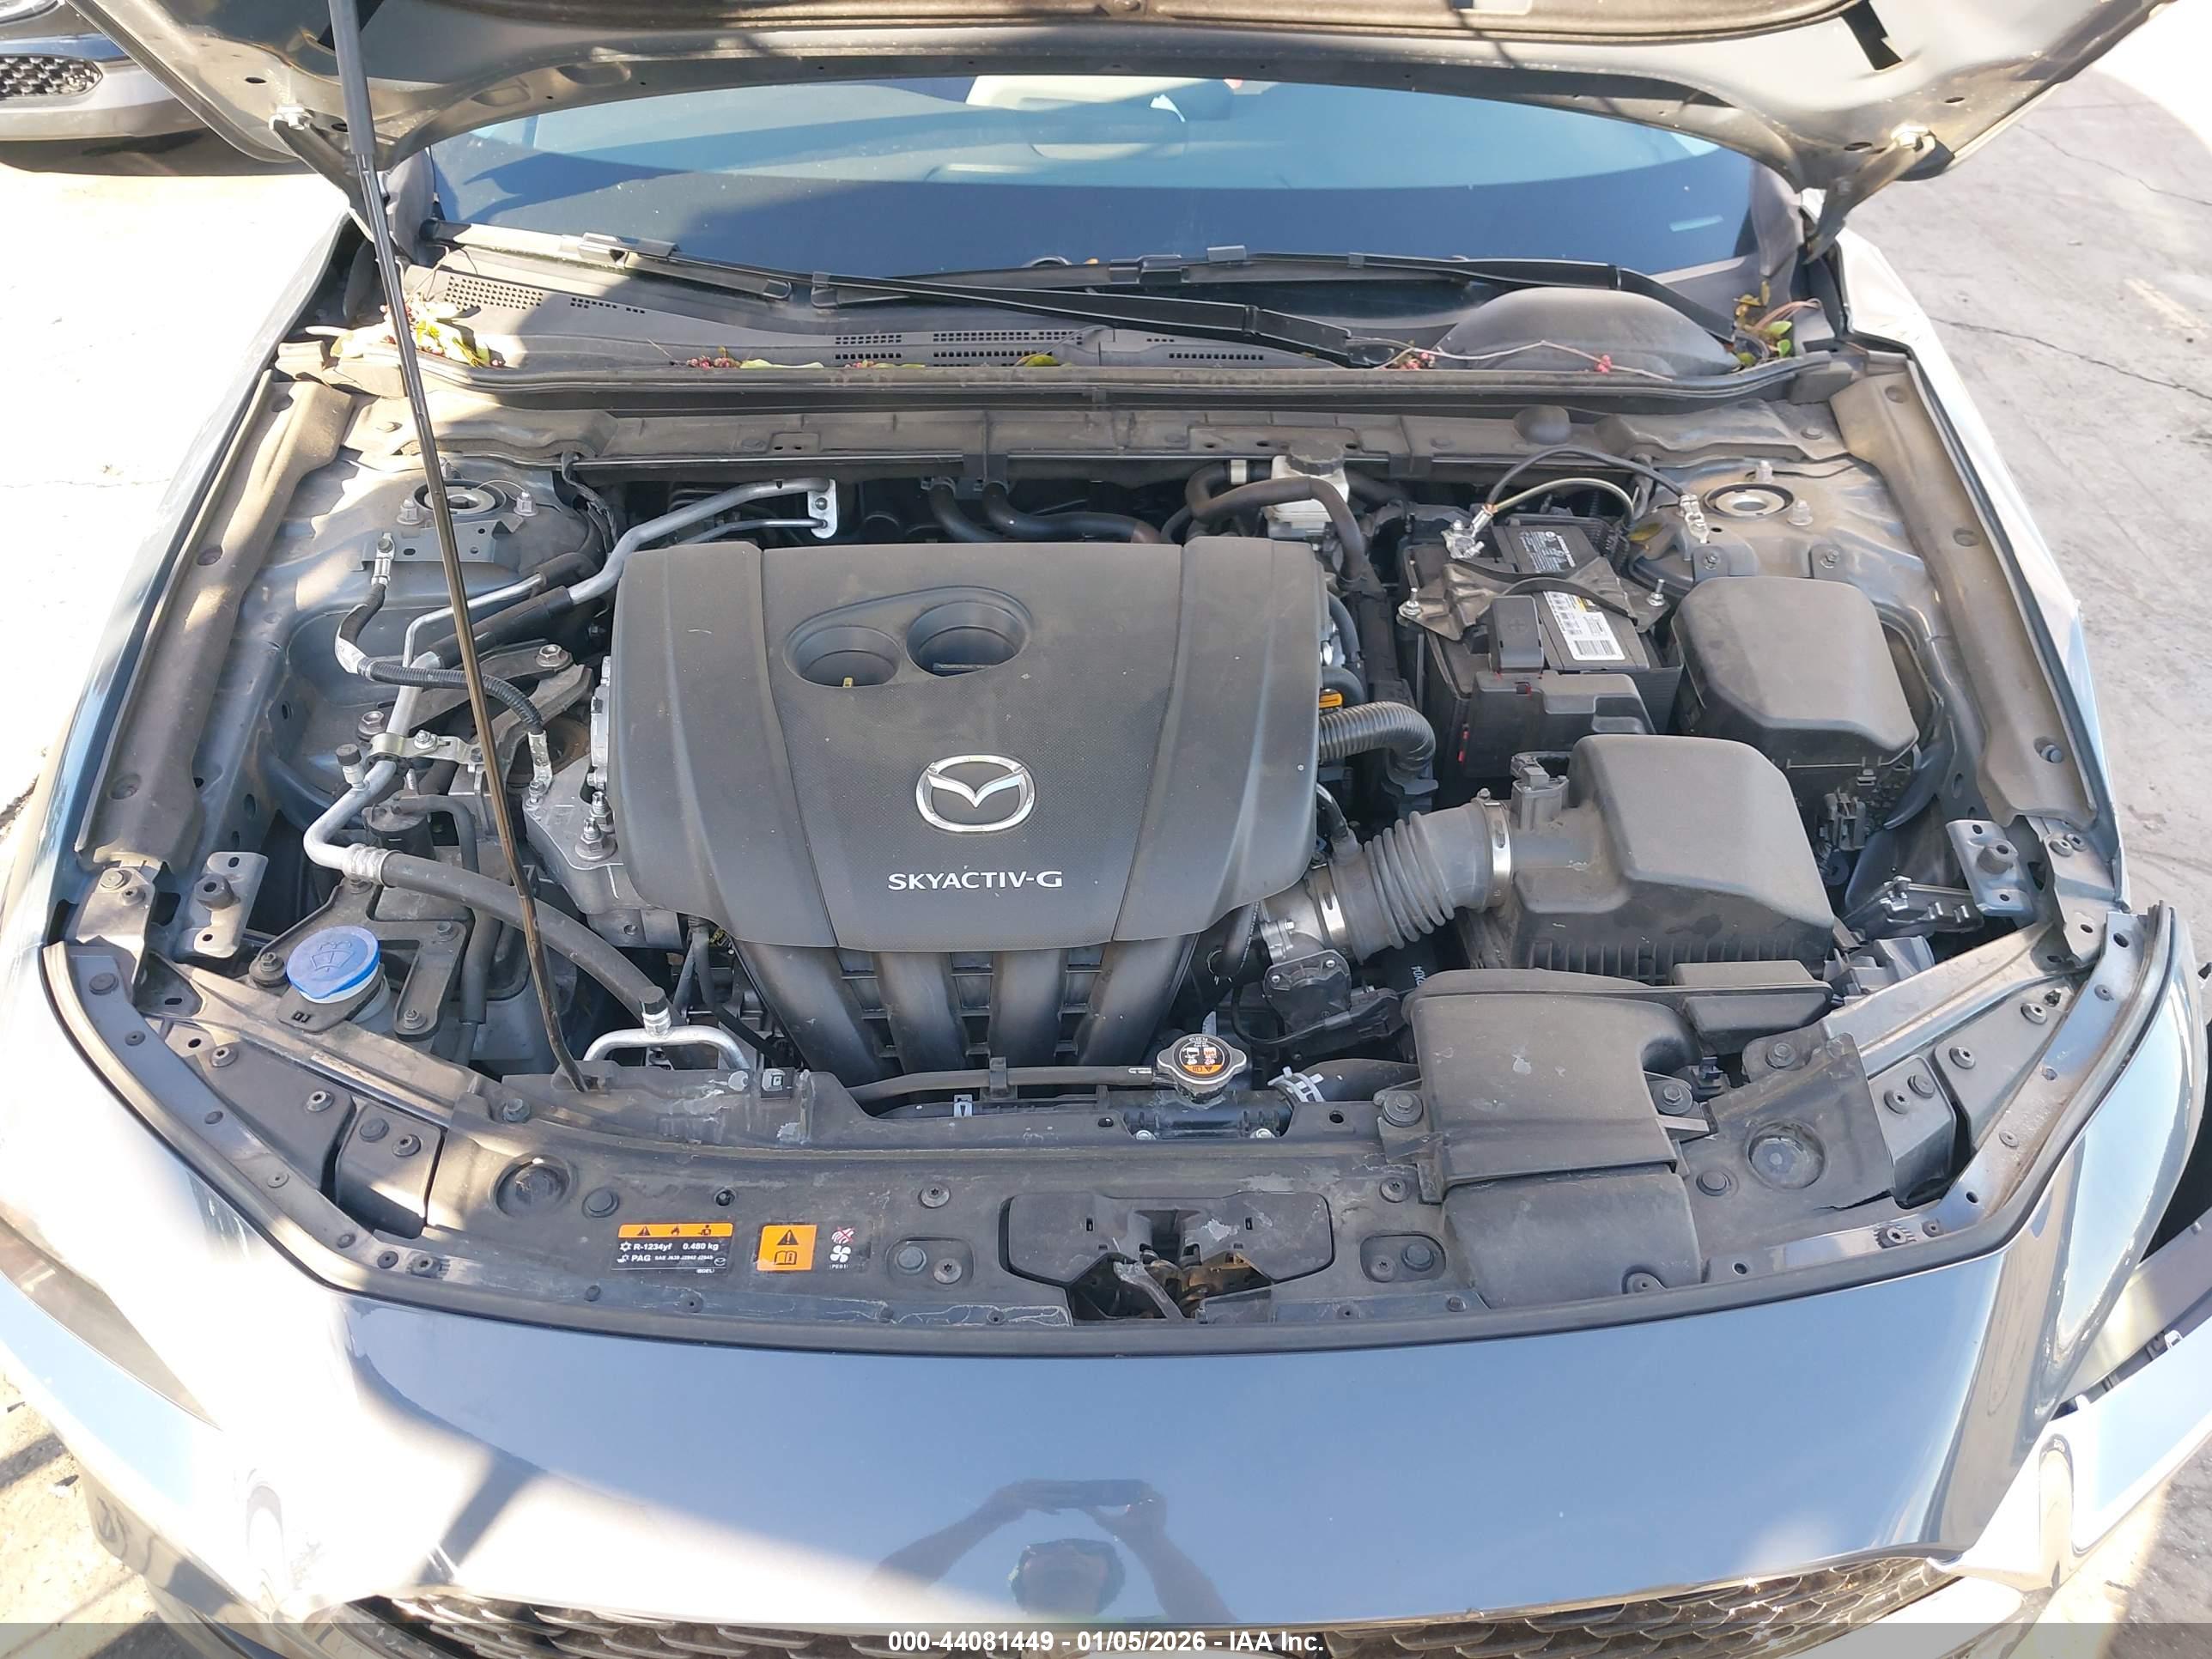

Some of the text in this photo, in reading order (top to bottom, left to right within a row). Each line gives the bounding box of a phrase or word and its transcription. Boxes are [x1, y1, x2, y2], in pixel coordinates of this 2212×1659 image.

[889, 872, 1062, 890] SKYACTIV-G
[633, 1243, 672, 1252] R-1234yf
[708, 1243, 719, 1252] kg
[631, 1254, 651, 1262] PAG
